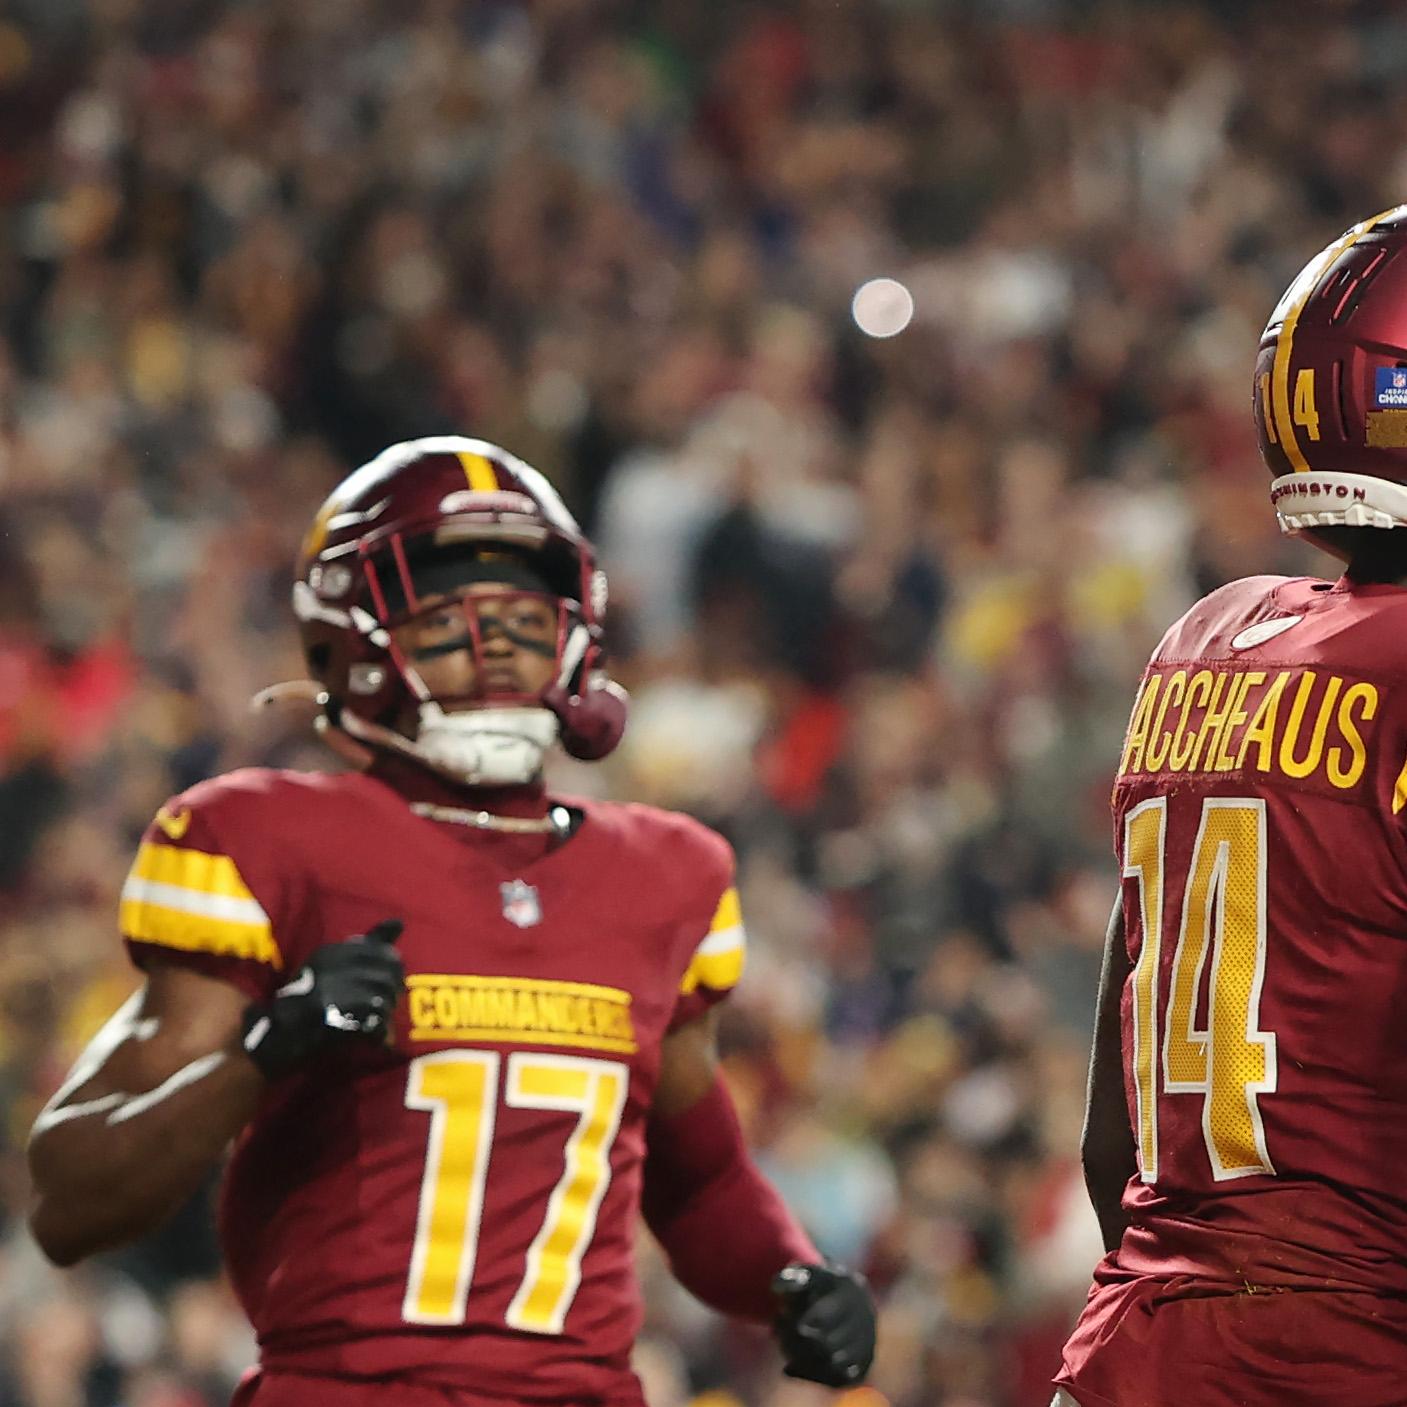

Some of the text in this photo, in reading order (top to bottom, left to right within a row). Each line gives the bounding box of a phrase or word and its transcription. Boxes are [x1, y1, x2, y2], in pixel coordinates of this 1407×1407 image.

[1119, 669, 1379, 789] ACCHEAUS
[1123, 795, 1277, 1183] 14
[401, 1048, 630, 1335] 17
